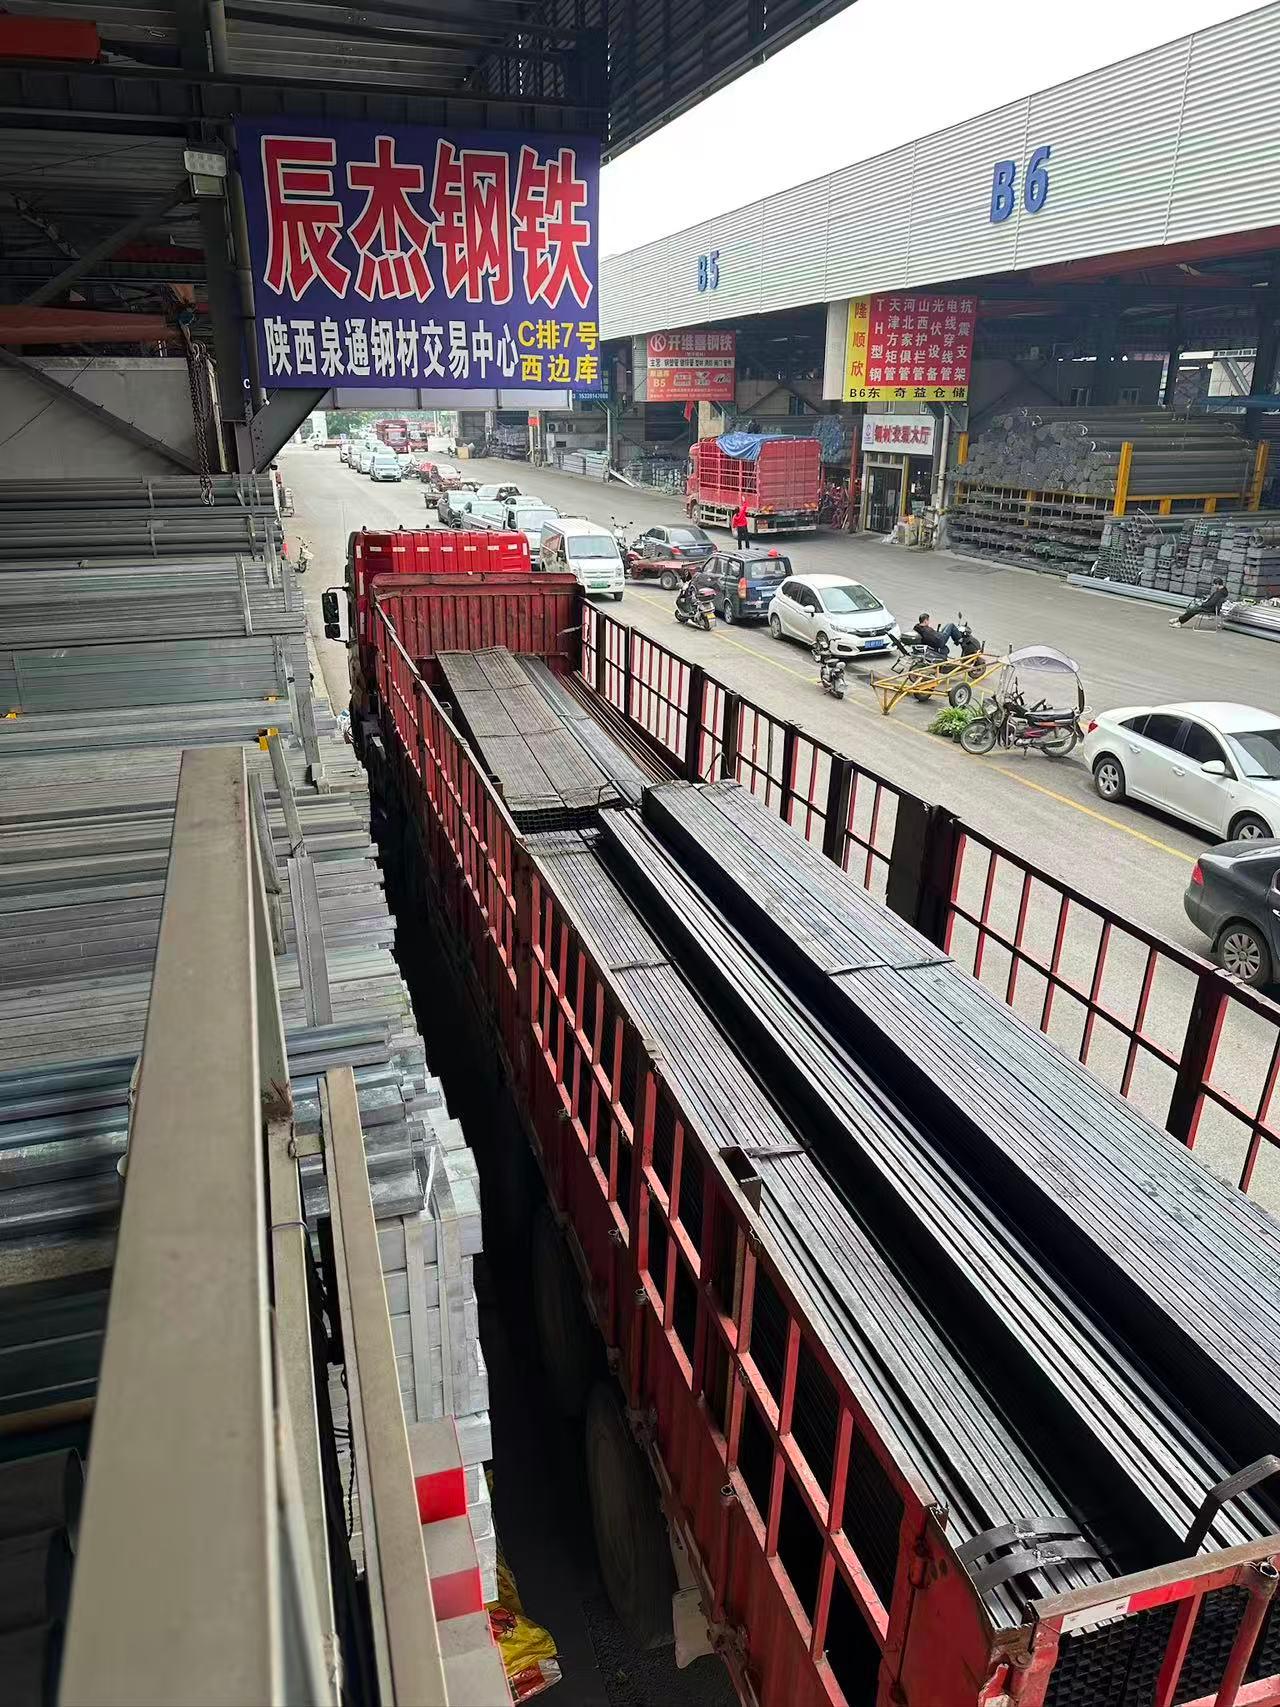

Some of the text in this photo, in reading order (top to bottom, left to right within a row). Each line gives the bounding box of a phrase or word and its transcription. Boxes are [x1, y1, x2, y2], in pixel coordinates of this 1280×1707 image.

[261, 135, 593, 309] 辰杰钢铁
[989, 145, 1051, 223] B6
[698, 250, 720, 292] B5
[263, 316, 519, 378] 陕西泉通钢材交易中心
[518, 320, 599, 351] C排7号
[520, 353, 598, 385] 西边库
[851, 302, 867, 376] 隆顺欣
[885, 299, 900, 381] 天津方矩管
[913, 300, 930, 381] 山西护栏管
[927, 299, 944, 381] 光伏设备
[941, 300, 957, 381] 电线穿线管
[954, 300, 973, 381] 抗震支架
[653, 379, 666, 388] B5
[850, 387, 966, 399] B6东 奇益仓储
